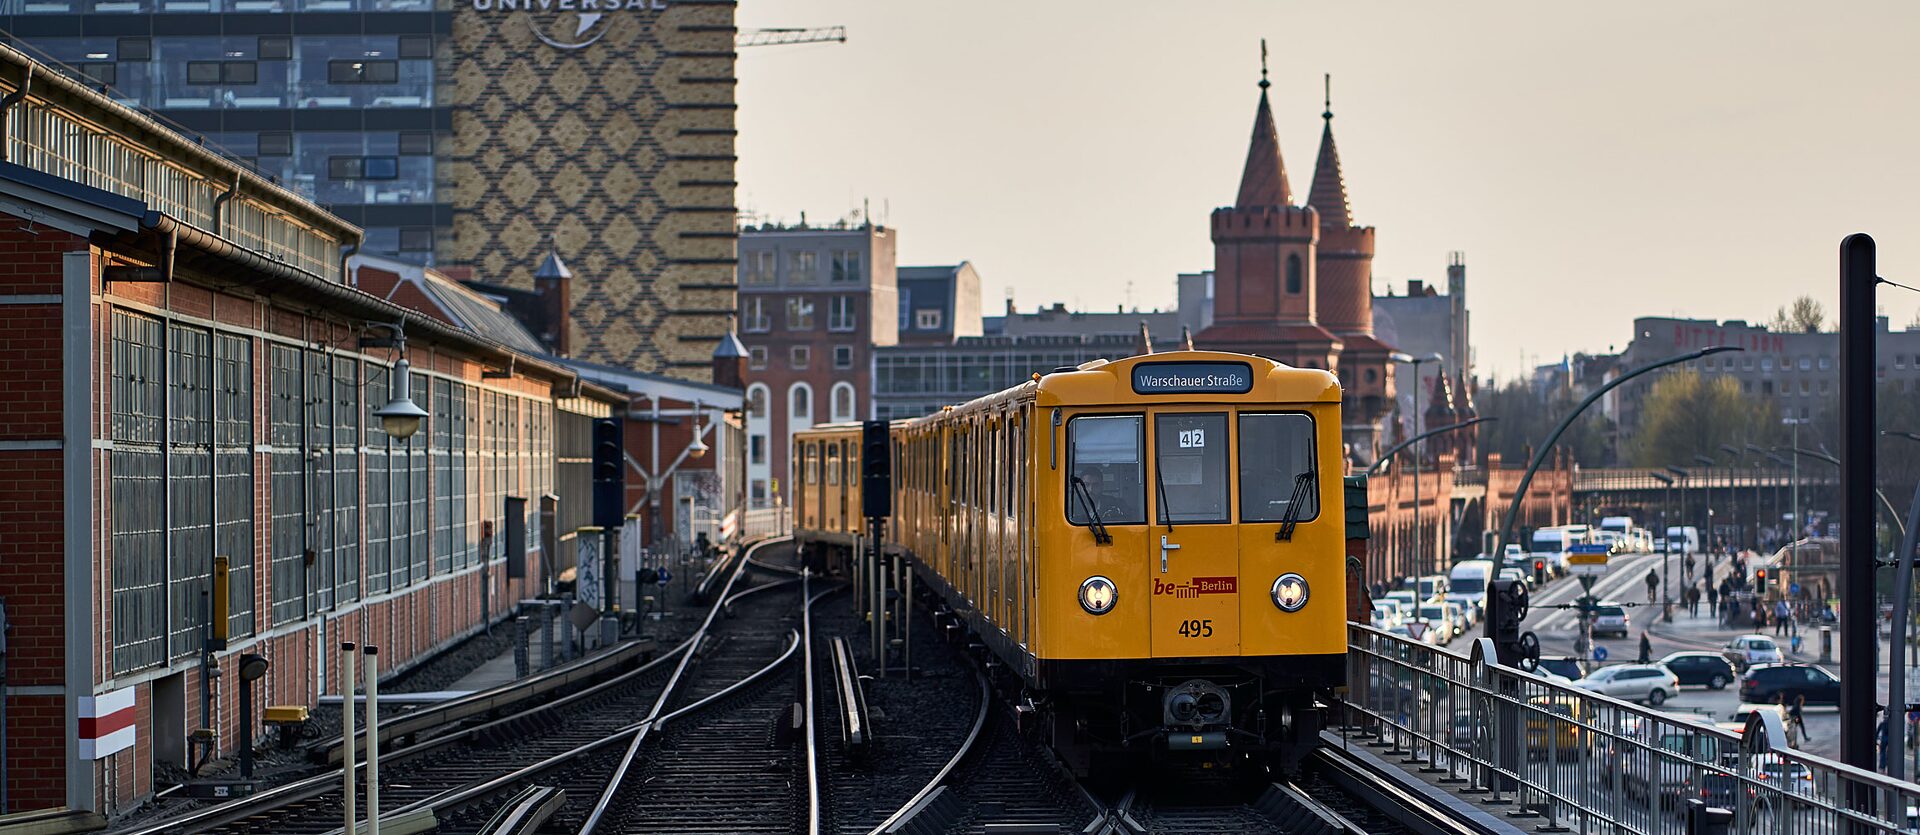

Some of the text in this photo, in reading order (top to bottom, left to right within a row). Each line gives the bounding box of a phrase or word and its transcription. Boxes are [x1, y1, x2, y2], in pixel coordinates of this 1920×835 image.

[473, 0, 667, 10] UNIVERSAL
[1140, 374, 1243, 387] Warschauer Straße
[1201, 581, 1233, 591] Berlin
[1178, 620, 1213, 638] 495
